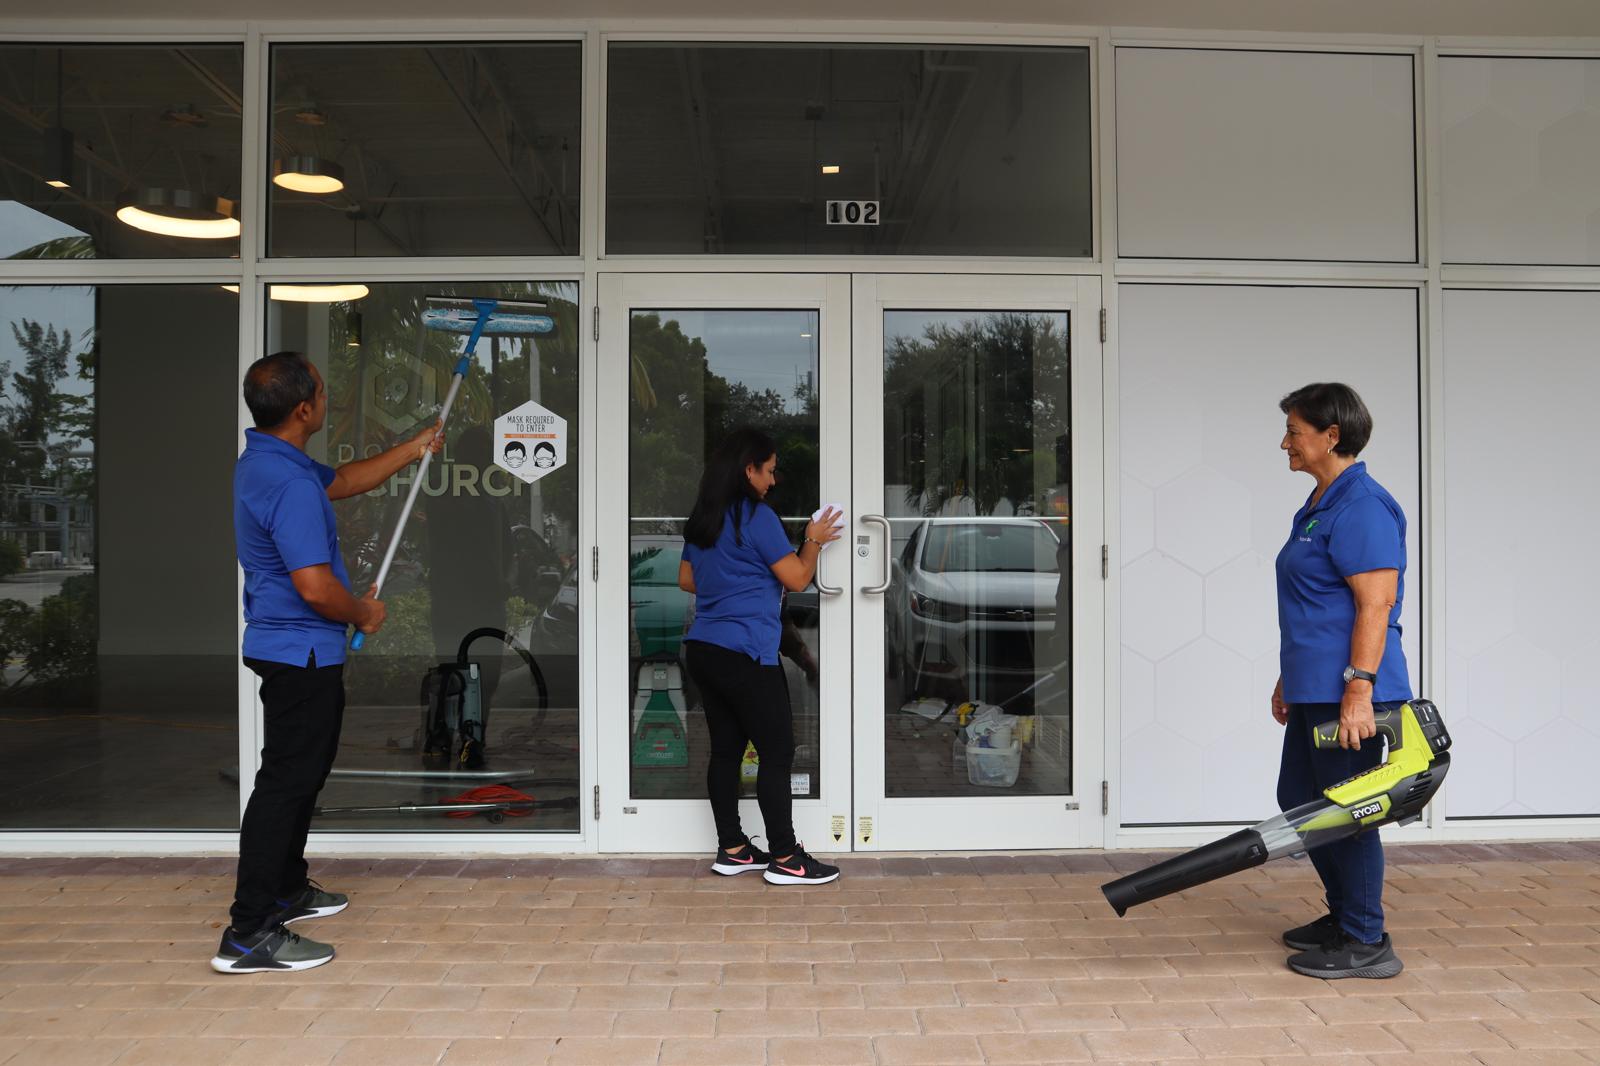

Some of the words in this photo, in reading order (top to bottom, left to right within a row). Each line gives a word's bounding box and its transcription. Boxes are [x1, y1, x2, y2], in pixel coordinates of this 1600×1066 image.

[830, 201, 877, 224] 102
[507, 415, 524, 424] MASK
[525, 415, 555, 425] REQUIRED
[516, 424, 524, 433] TO
[526, 424, 546, 433] ENTER
[338, 443, 456, 463] DOL
[363, 463, 541, 498] HURC
[1351, 803, 1382, 819] RYOBI
